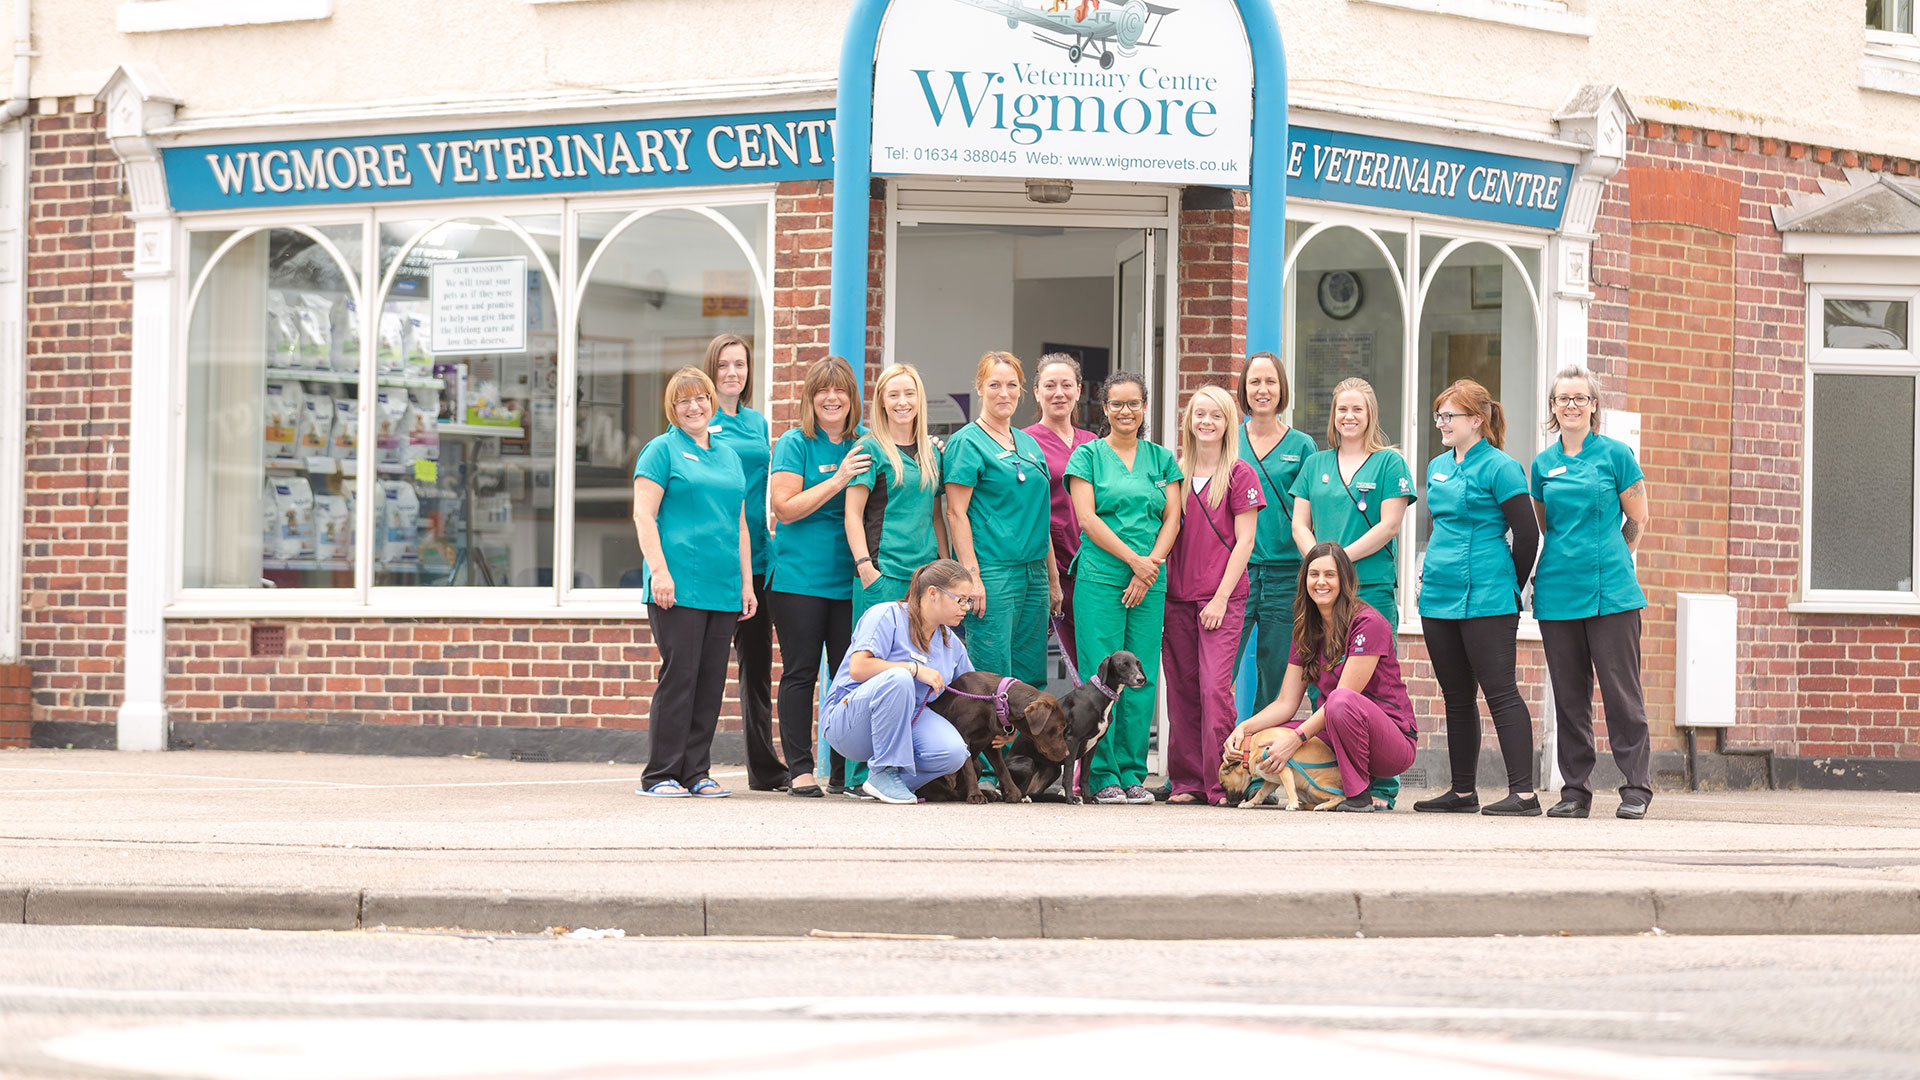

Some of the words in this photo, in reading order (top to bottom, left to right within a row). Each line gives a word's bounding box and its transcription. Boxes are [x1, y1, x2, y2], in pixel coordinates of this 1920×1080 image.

[1012, 62, 1131, 93] Veterinary
[1139, 67, 1217, 91] Centre
[910, 69, 1218, 146] Wigmore
[205, 143, 412, 195] WIGMORE
[418, 126, 693, 184] VETERINARY
[705, 117, 835, 170] CENT
[884, 146, 909, 161] Tel:
[913, 147, 958, 163] 01634
[963, 149, 1017, 164] 388045
[1026, 151, 1063, 166] Web:
[1067, 153, 1238, 172] www.wigmorevets.co.uk
[1312, 144, 1466, 198] VETERINARY
[1467, 165, 1563, 211] CENTRE
[453, 266, 469, 275] OUR
[472, 264, 504, 273] MISSION
[446, 279, 456, 287] We
[459, 278, 473, 287] will
[476, 278, 493, 286] treat
[495, 278, 512, 287] your
[443, 291, 458, 301] pets
[479, 289, 494, 299] they
[472, 301, 484, 310] and
[487, 300, 514, 311] promise
[449, 313, 464, 324] help
[481, 313, 495, 323] give
[498, 311, 515, 321] them
[441, 326, 451, 335] the
[454, 325, 481, 335] lifelong
[501, 324, 514, 332] and
[463, 337, 478, 346] they
